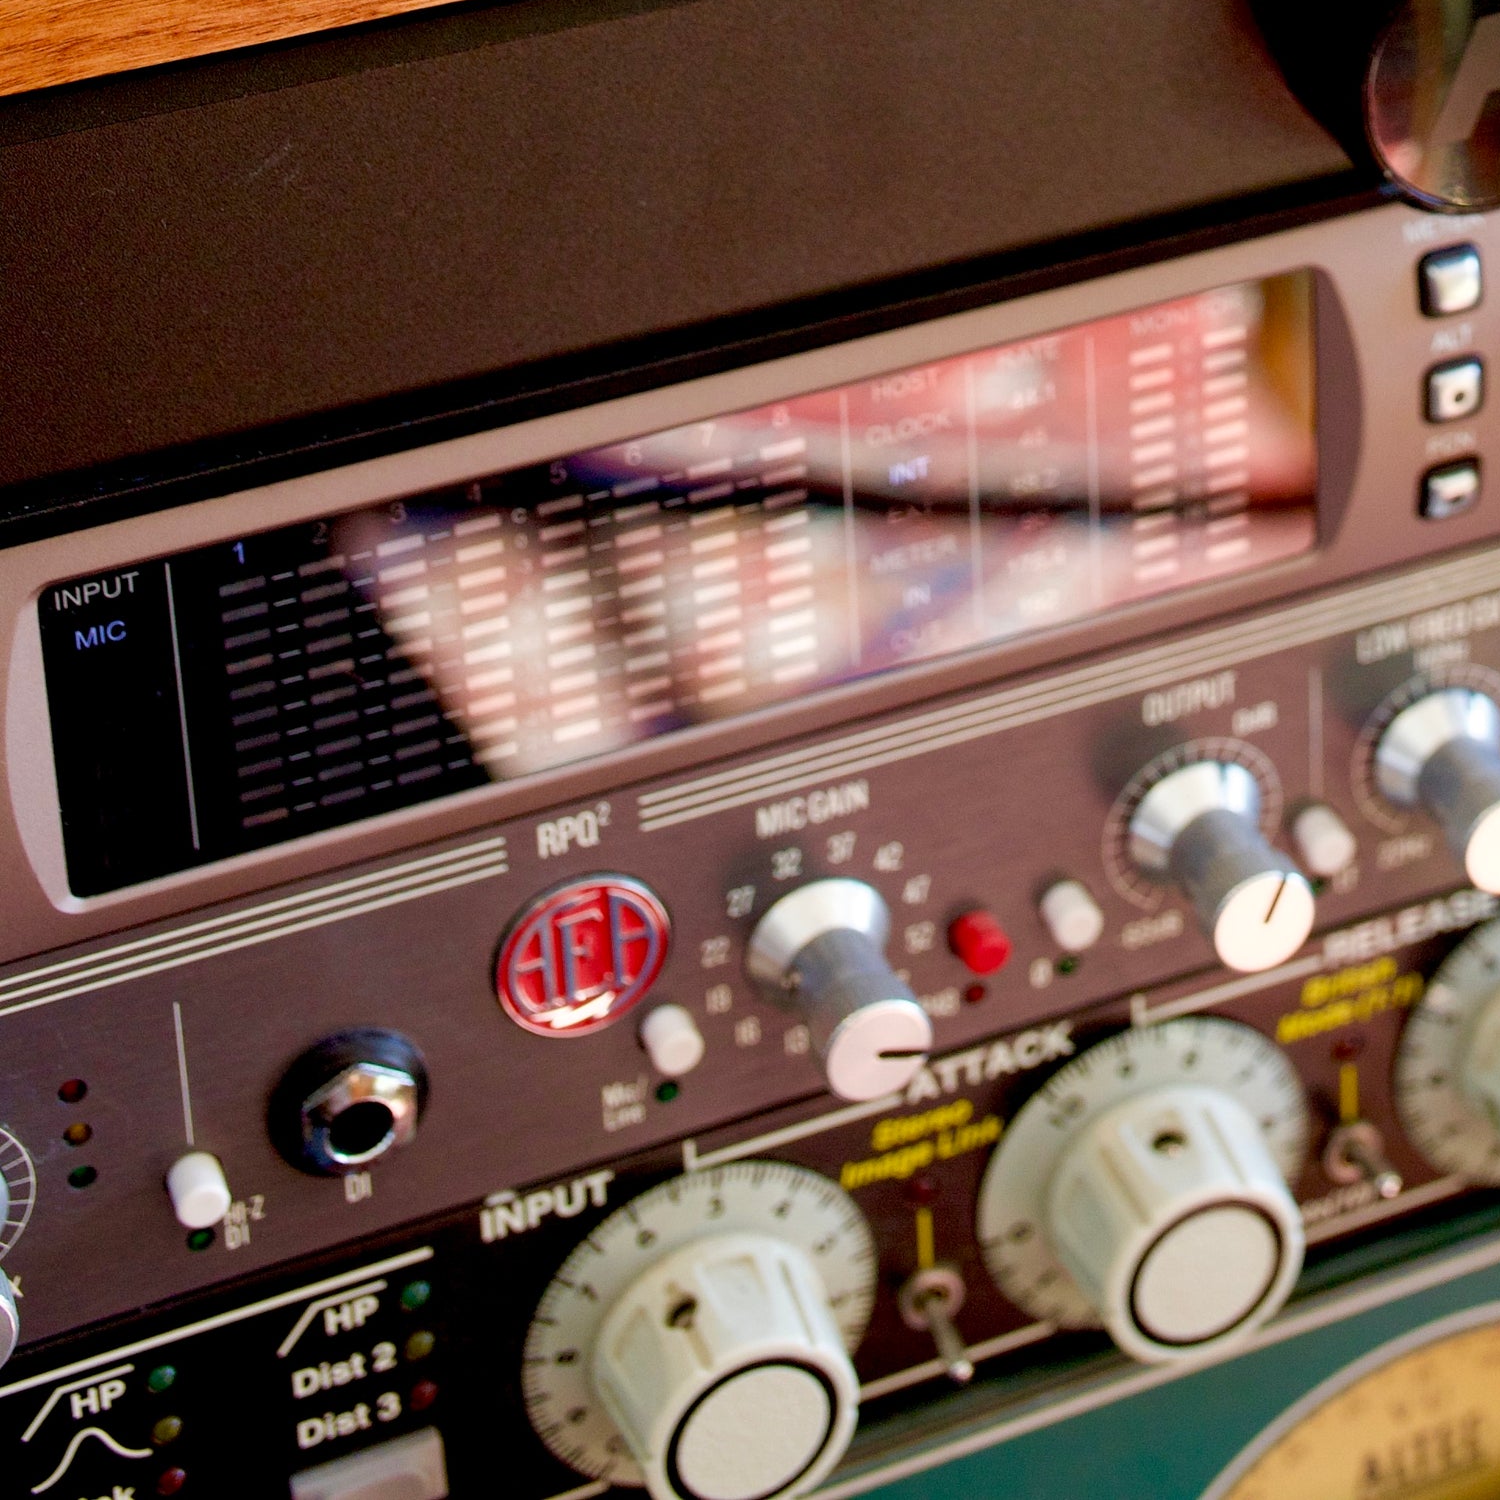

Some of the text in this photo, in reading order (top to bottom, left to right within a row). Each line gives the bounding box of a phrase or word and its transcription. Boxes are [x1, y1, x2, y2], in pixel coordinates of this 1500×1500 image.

[232, 541, 245, 564] 1
[311, 521, 328, 544] 2
[54, 571, 140, 612] INPUT
[74, 620, 127, 650] MIC
[1142, 670, 1236, 726] OUTPUT
[755, 779, 870, 840] MIC GAIN
[905, 1018, 1077, 1105] ATTACK
[872, 1098, 975, 1151] Stereo
[344, 1173, 372, 1203] DI
[839, 1140, 935, 1193] Image
[479, 1168, 616, 1244] INPUT
[225, 1220, 251, 1250] DI
[324, 1295, 380, 1336] HP
[291, 1341, 399, 1399] Dist 2
[70, 1380, 127, 1419] HP
[297, 1390, 402, 1450] Dist 3
